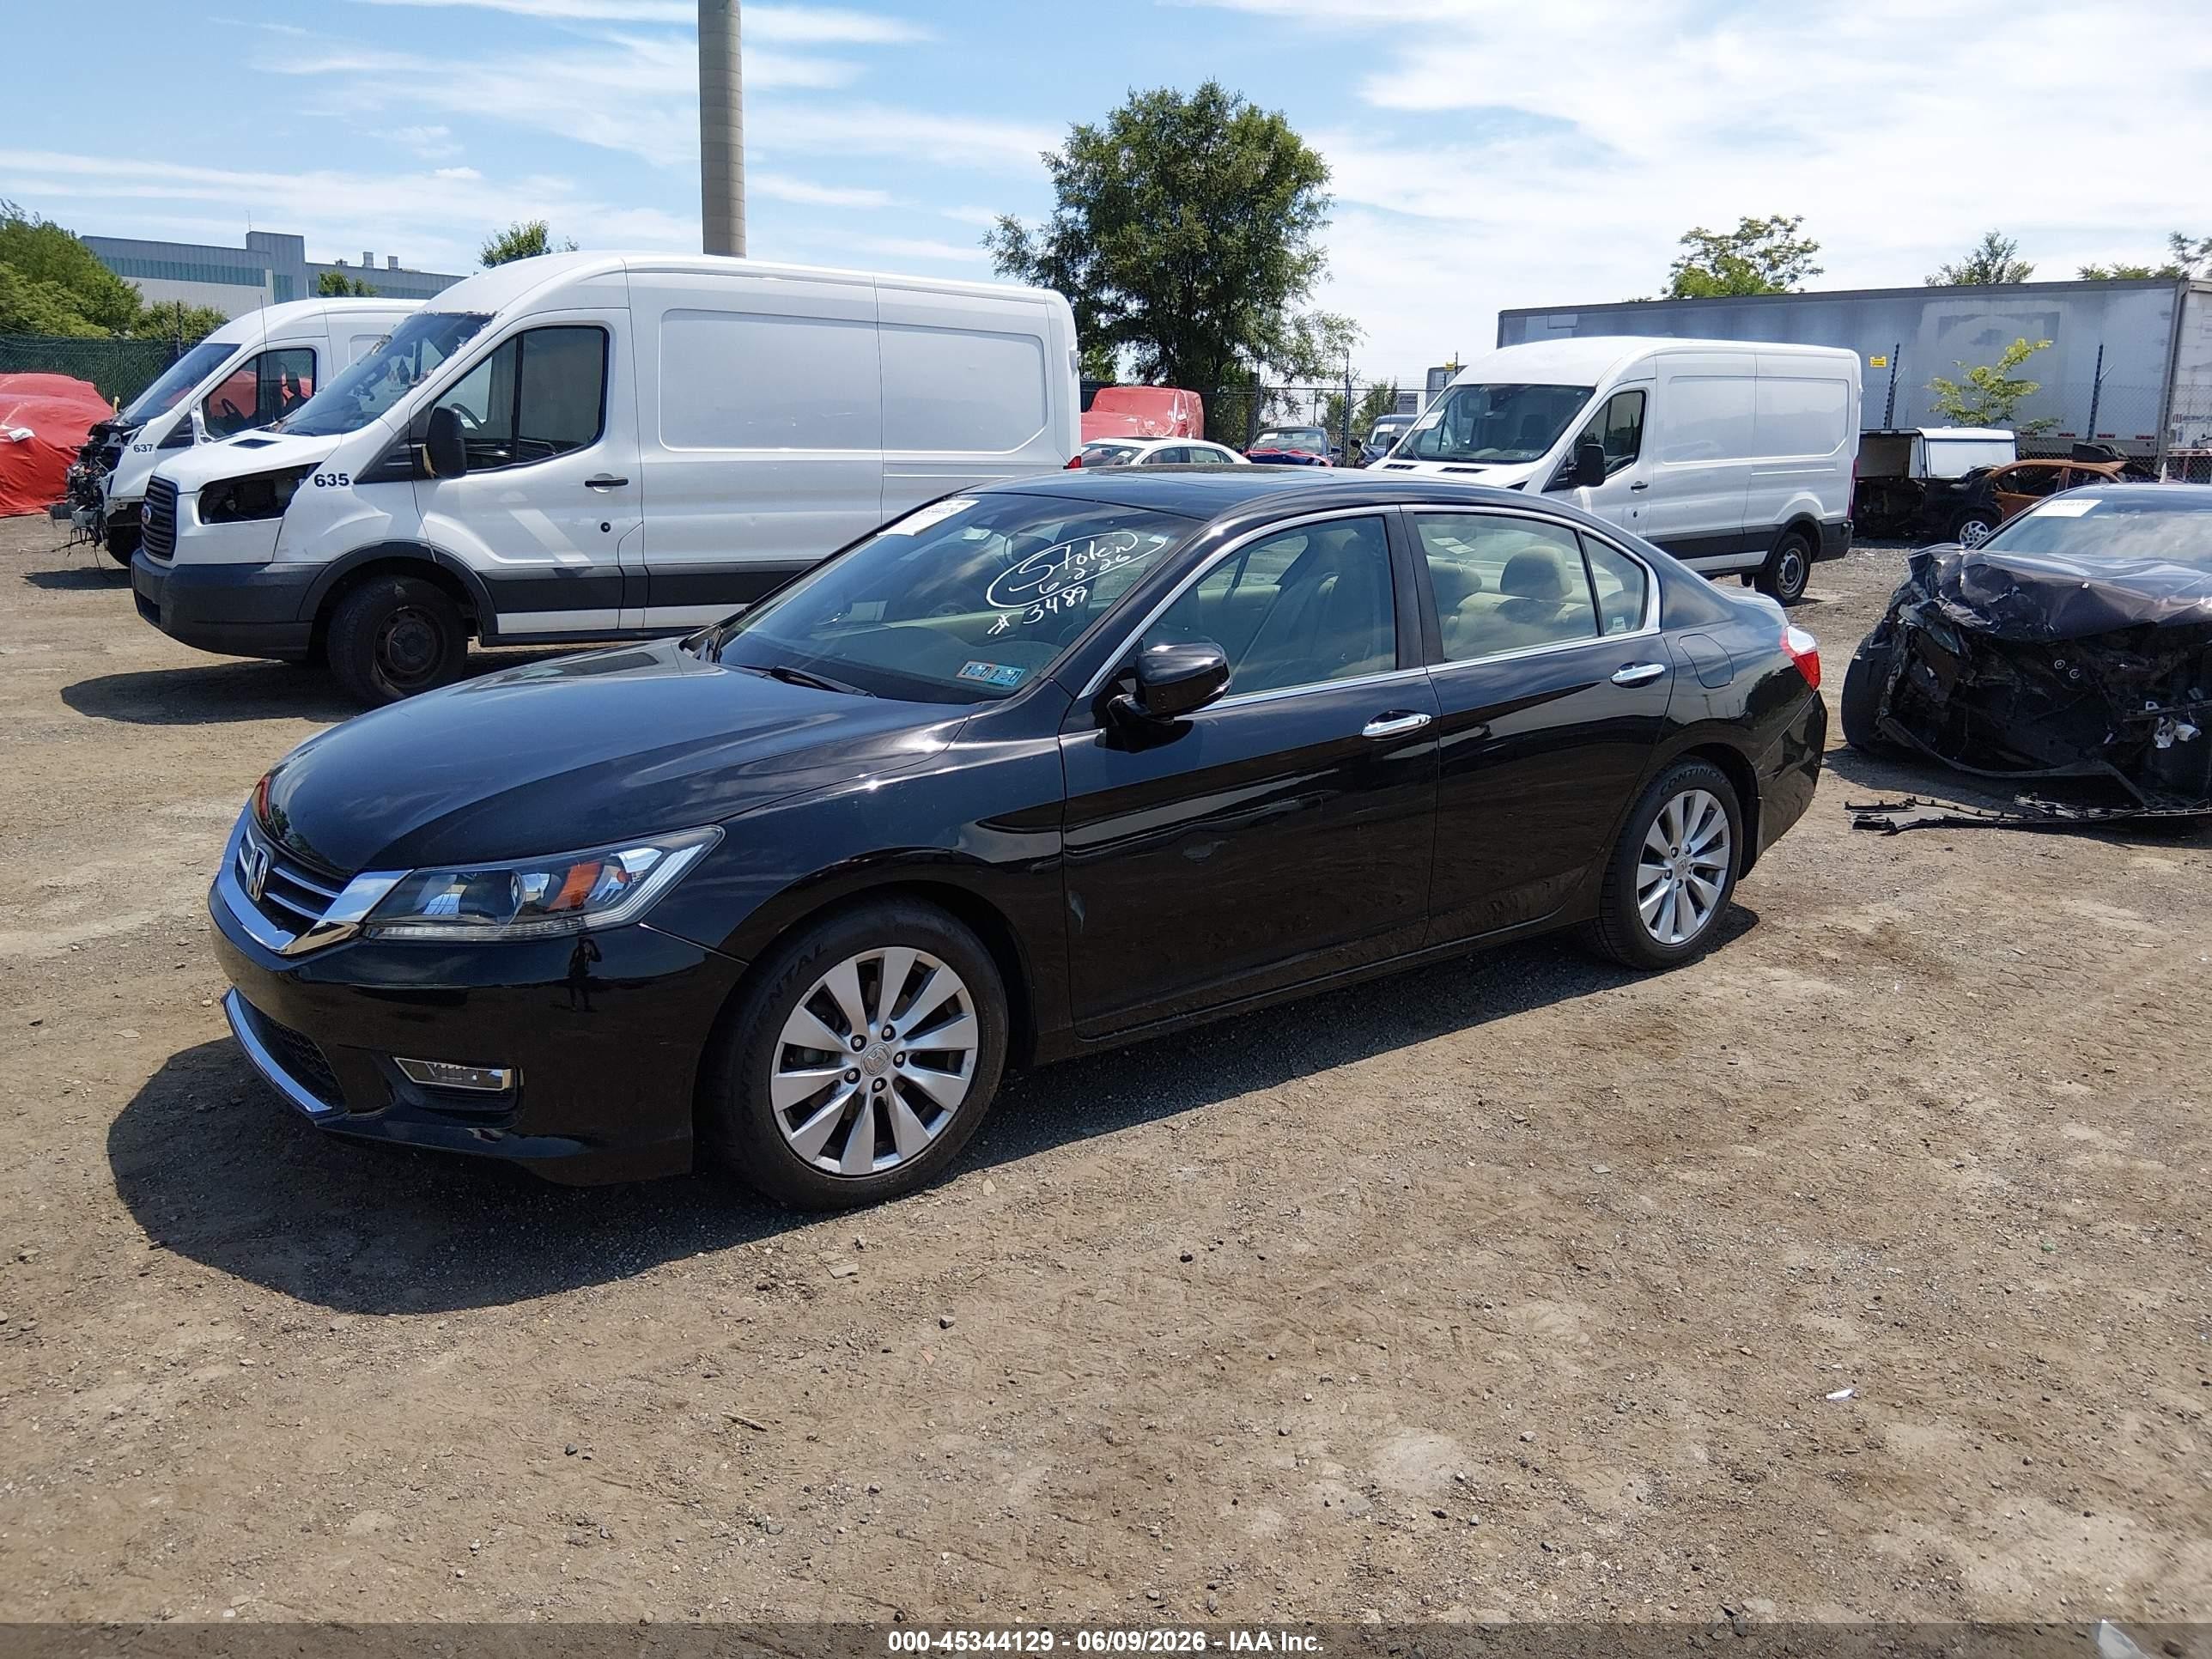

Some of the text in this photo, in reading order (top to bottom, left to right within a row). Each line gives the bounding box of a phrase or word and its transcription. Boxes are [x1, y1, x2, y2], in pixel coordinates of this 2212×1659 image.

[133, 443, 155, 454] 637
[313, 473, 350, 488] 635
[1009, 540, 1132, 592] Stolen
[1023, 586, 1089, 625] 3489
